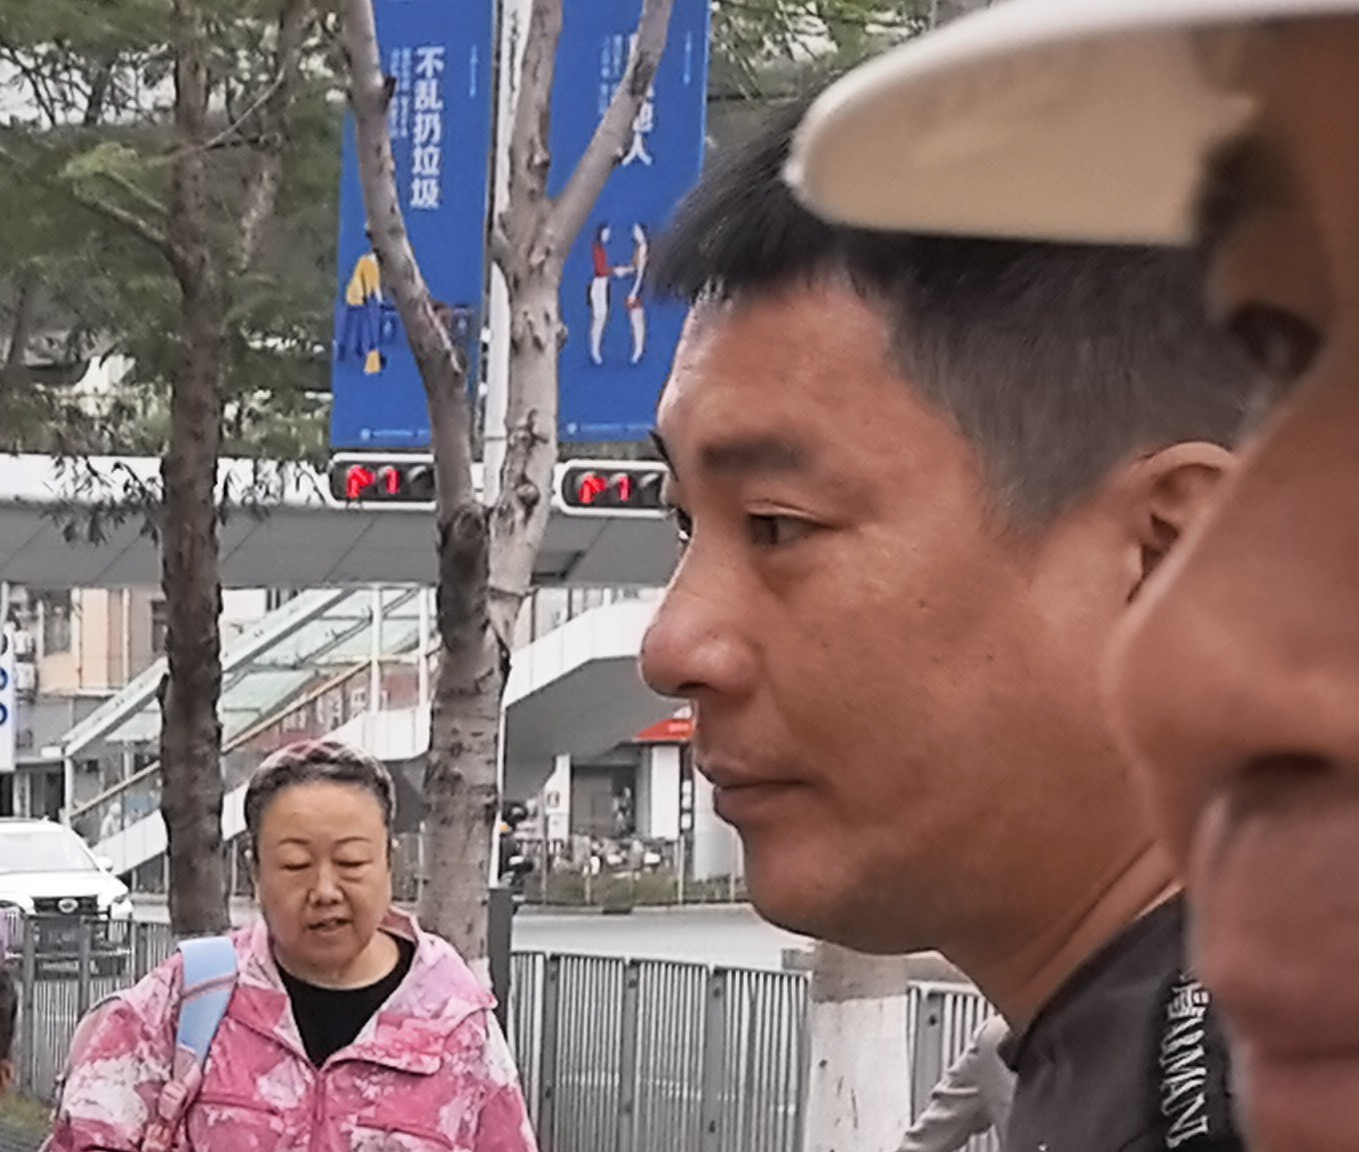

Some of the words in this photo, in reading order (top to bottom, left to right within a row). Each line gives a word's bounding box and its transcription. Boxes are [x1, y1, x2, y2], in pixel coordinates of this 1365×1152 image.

[410, 46, 445, 209] 不乱扔垃圾
